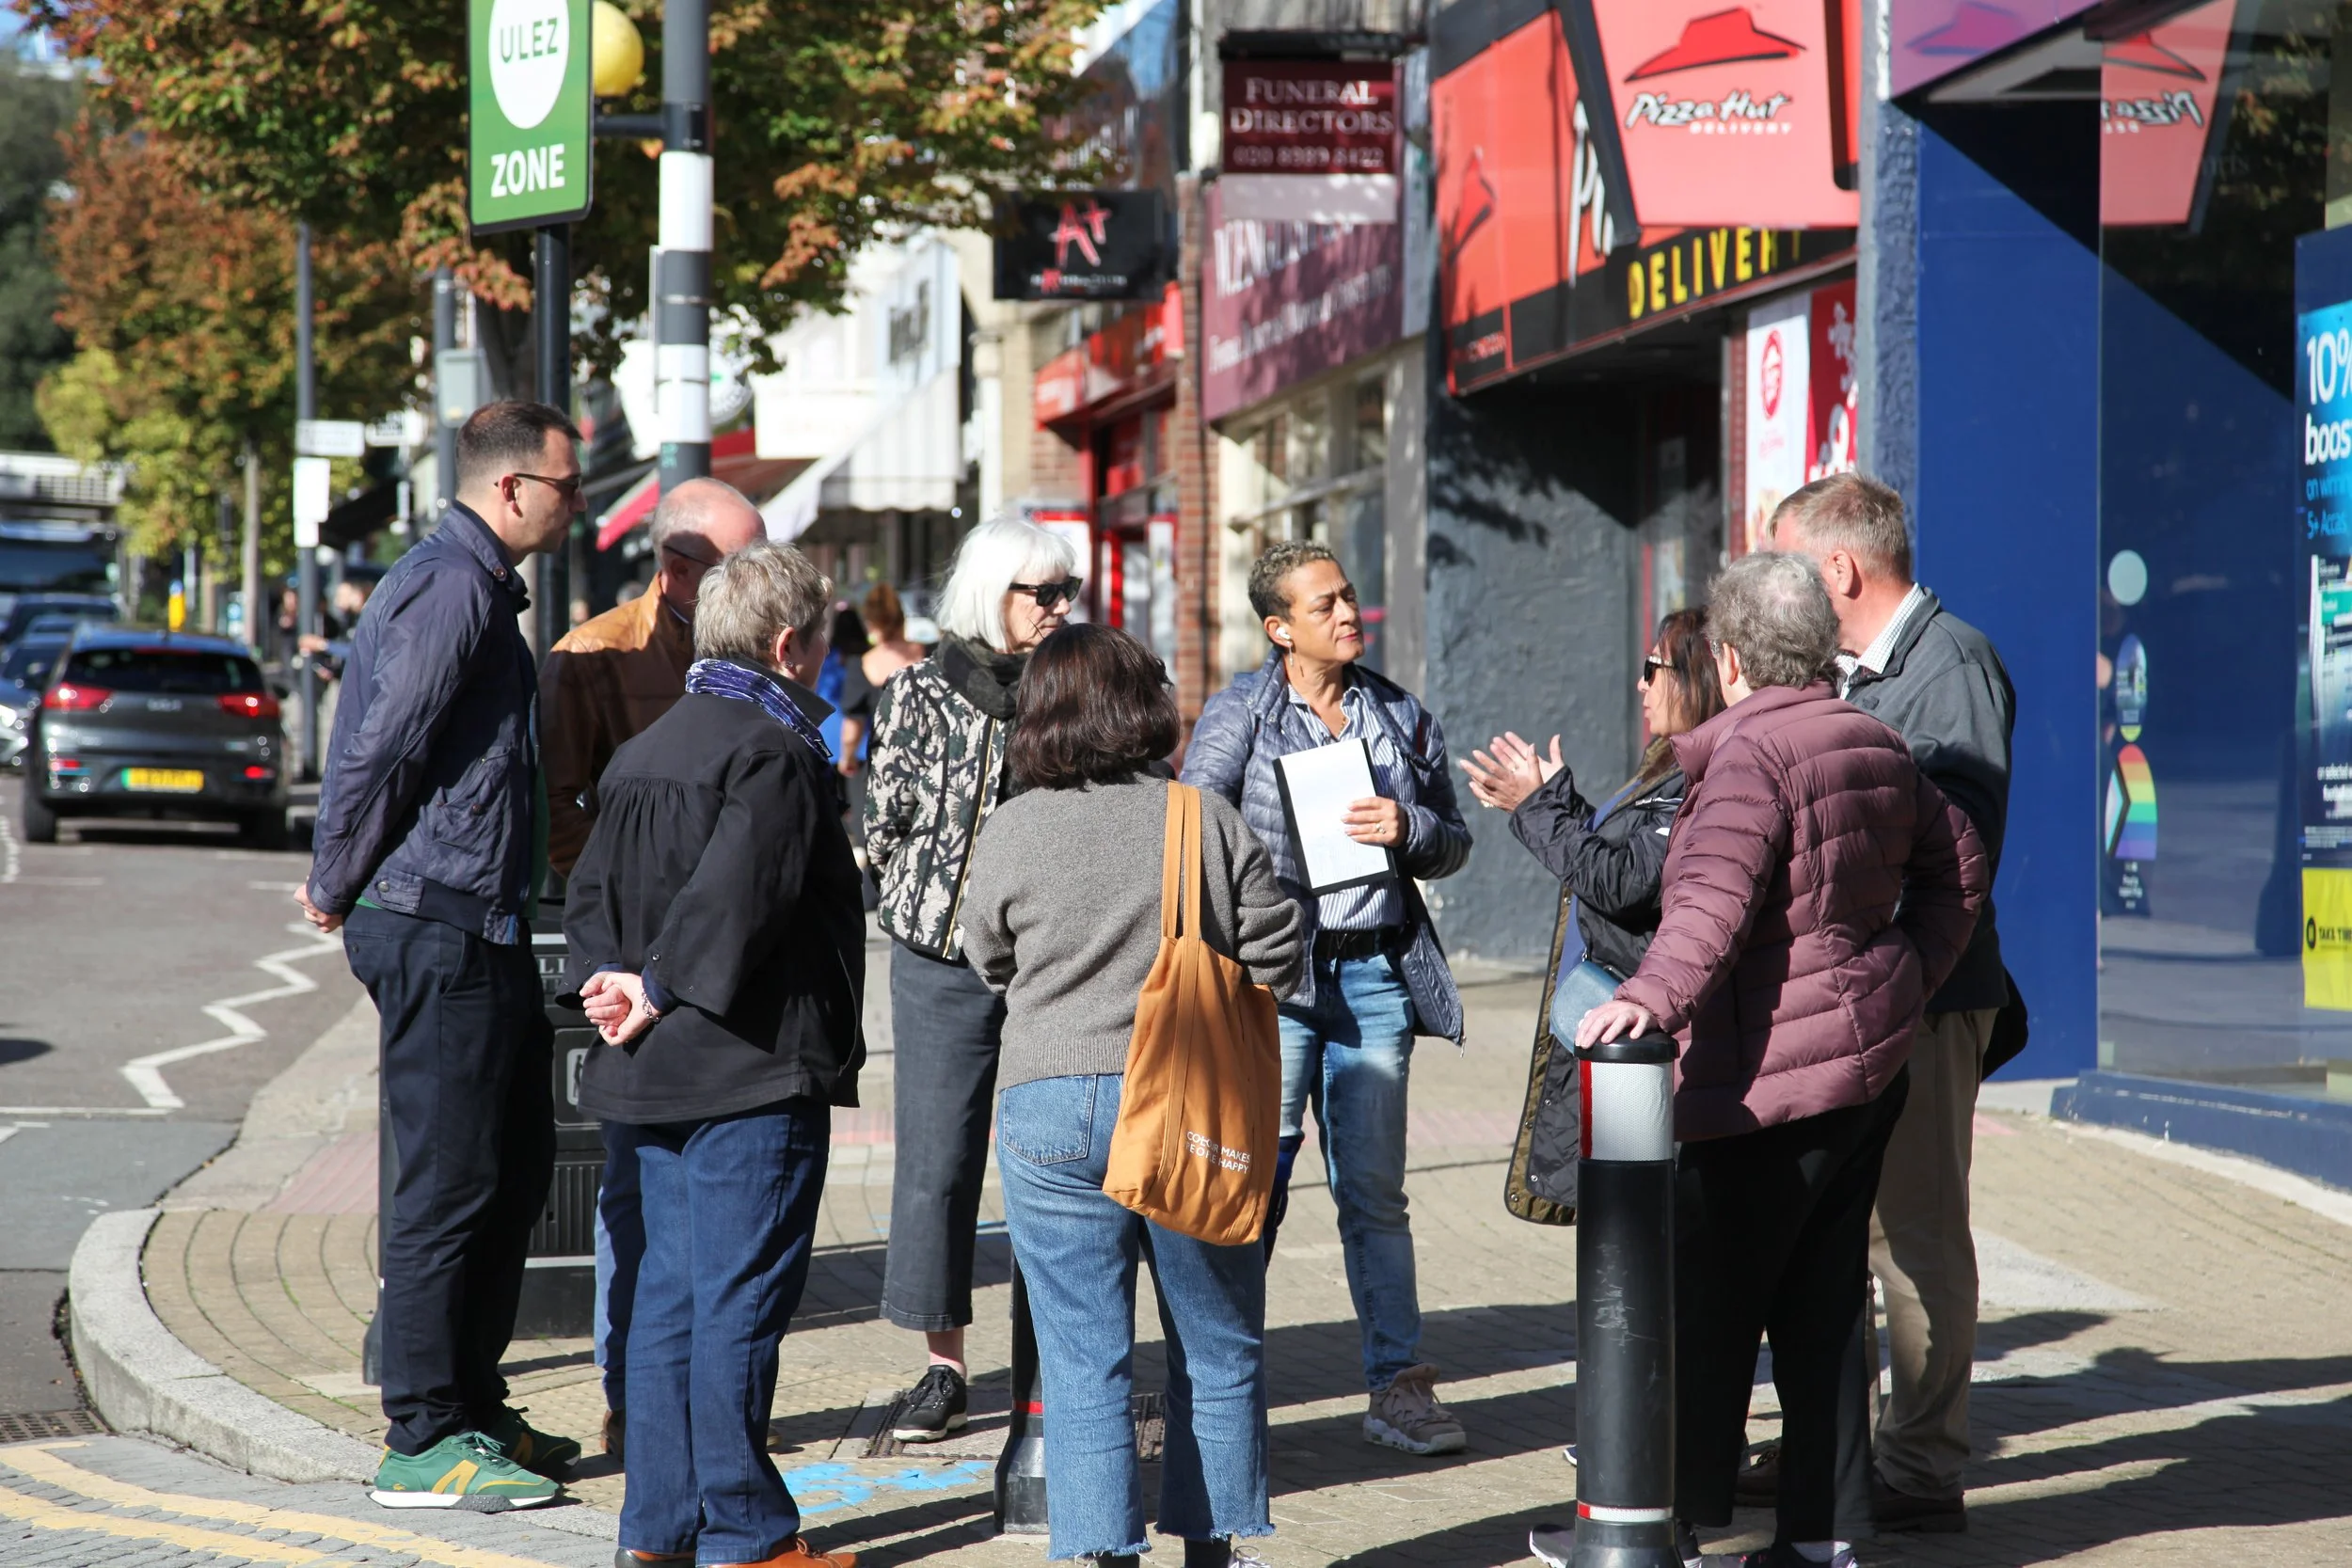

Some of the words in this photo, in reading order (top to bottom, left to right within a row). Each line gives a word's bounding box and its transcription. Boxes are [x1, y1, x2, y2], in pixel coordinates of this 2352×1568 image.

[500, 17, 558, 64] ULEZ
[1246, 77, 1378, 105] FUNERAL
[1625, 91, 1714, 130] Pizza
[1719, 88, 1793, 123] Hut
[1230, 106, 1394, 135] DIRECTORS
[490, 143, 564, 198] ZONE
[2305, 412, 2352, 465] boos
[1186, 1131, 1219, 1153] COLOR
[1221, 1147, 1250, 1164] MAKES
[1218, 1157, 1249, 1175] HAPPY
